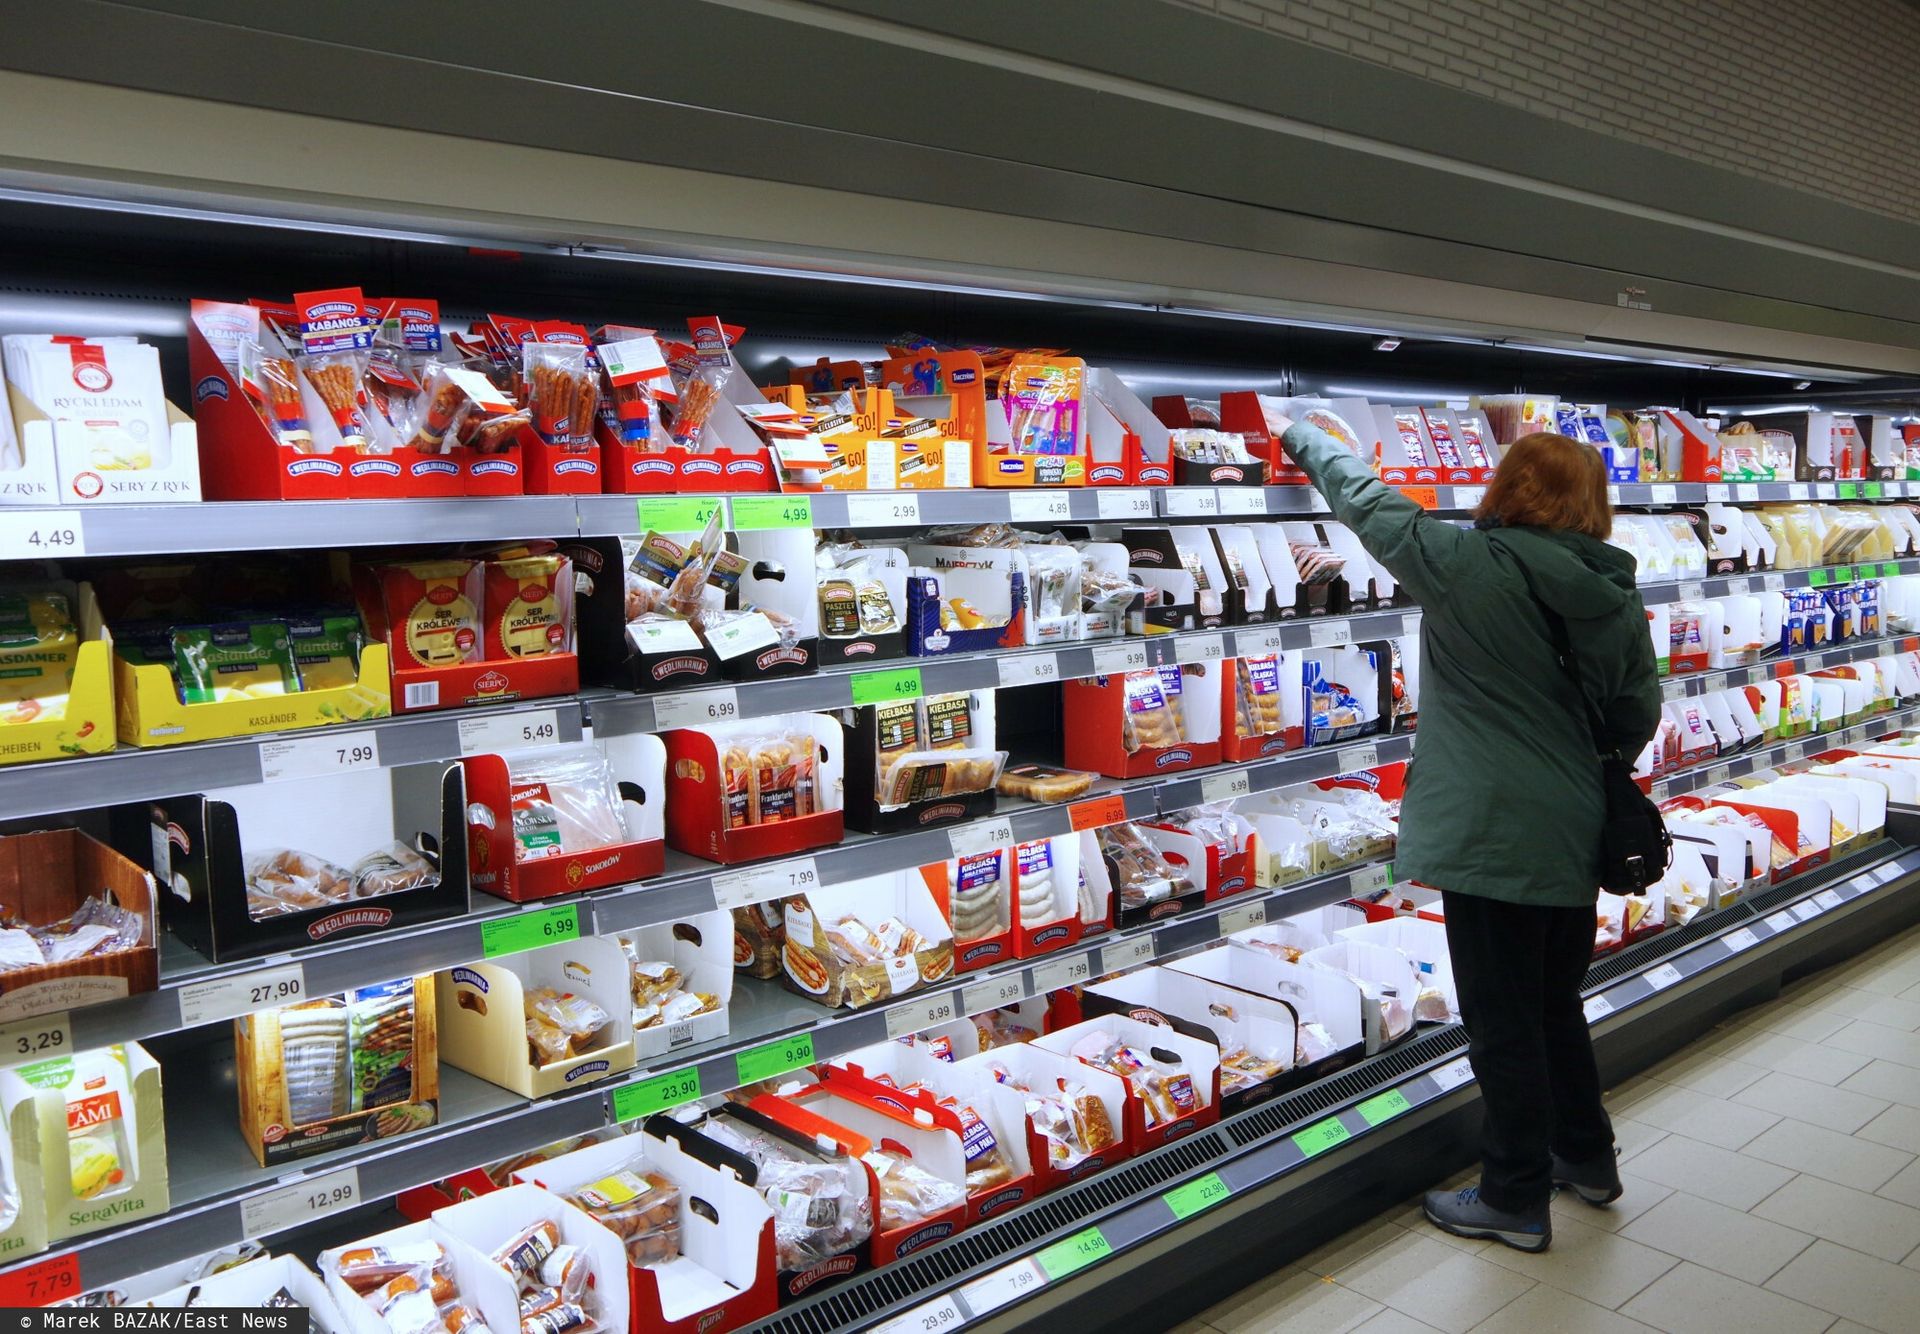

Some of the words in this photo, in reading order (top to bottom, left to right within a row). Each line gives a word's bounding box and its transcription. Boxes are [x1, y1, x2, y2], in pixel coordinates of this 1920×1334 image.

[312, 302, 353, 317] WĘDLINIARNIA
[307, 317, 362, 332] KABANOS
[856, 412, 876, 433] GO!
[940, 418, 958, 437] GO!
[848, 449, 865, 467] GO!
[926, 449, 943, 466] GO!
[293, 462, 339, 475] WĘDLINIARNIA
[355, 462, 400, 475] WĘDLINIARNIA
[414, 461, 458, 474] WĘDLINIARNIA
[473, 461, 515, 474] WĘDLINIARNIA
[556, 461, 595, 473] WĘDLINIARNIA
[635, 461, 674, 472] WĘDLINIARNIA
[684, 461, 720, 472] WĘDLINIARNIA
[729, 461, 763, 472] WĘDLINIARNIA
[17, 482, 47, 496] RYK
[111, 481, 144, 492] SERY
[150, 482, 159, 491] Z
[163, 481, 191, 493] RYK
[1048, 502, 1068, 515] 4,89
[1133, 500, 1150, 511] 3,99
[1199, 498, 1215, 509] 3,99
[1249, 498, 1264, 508] 3,69
[695, 509, 714, 523] 4,9
[783, 508, 807, 522] 4,99
[893, 506, 916, 518] 2,99
[29, 530, 75, 549] 4,49
[526, 608, 543, 617] SER
[825, 602, 855, 611] PASZTET
[434, 610, 452, 619] SER
[1264, 637, 1280, 648] 4,99
[1205, 645, 1220, 656] 3,99
[1127, 653, 1145, 665] 9,99
[657, 659, 704, 678] WĘDLINIARNIA
[1035, 664, 1053, 676] 8,99
[477, 680, 506, 689] SIERPC
[895, 680, 917, 693] 4,99
[708, 703, 735, 718] 6,99
[879, 705, 914, 720] KIEŁBASA
[929, 700, 967, 715] KIEŁBASA
[249, 712, 297, 726] KASLÄNDER
[523, 723, 553, 741] 5,49
[337, 746, 373, 765] 7,99
[1363, 754, 1376, 765] 7,99
[1231, 780, 1247, 791] 9,99
[924, 807, 961, 820] WĘDLINIARNIA
[1106, 808, 1124, 822] 6,99
[989, 828, 1010, 841] 7,99
[1019, 845, 1046, 858] IEŁBASA
[585, 853, 621, 875] SOKOŁÓW
[962, 856, 997, 874] KIEŁBASA
[789, 870, 814, 886] 7,99
[316, 911, 384, 935] WĘDLINIARNIA
[1249, 911, 1264, 923] 5,49
[544, 918, 573, 936] 6,99
[1036, 928, 1066, 943] WĘDLINIARNIA
[966, 945, 999, 960] WĘDLINIARNIA
[1135, 943, 1151, 956] 9,99
[1069, 964, 1087, 977] 7,99
[455, 968, 487, 992] WĘDLINIARNIA
[251, 980, 299, 1003] 27,90
[1000, 985, 1019, 998] 9,99
[928, 1005, 950, 1021] 8,99
[673, 1023, 691, 1034] TAKIE
[17, 1030, 64, 1054] 3,29
[786, 1045, 810, 1063] 9,90
[569, 1062, 607, 1081] WĘDLINIARNIA
[662, 1080, 696, 1100] 23,90
[72, 1104, 112, 1127] AMI
[1323, 1125, 1345, 1141] 39,90
[308, 1185, 352, 1209] 12,99
[1200, 1182, 1225, 1199] 22,90
[983, 1190, 1020, 1212] WĘDLINIARNIA
[900, 1225, 949, 1254] WĘDLINIARNIA
[1078, 1236, 1105, 1255] 14,90
[794, 1257, 851, 1291] WĘDLINIARNIA
[1009, 1271, 1034, 1290] 7,99
[27, 1272, 73, 1298] 7,79
[922, 1307, 955, 1331] 29,90
